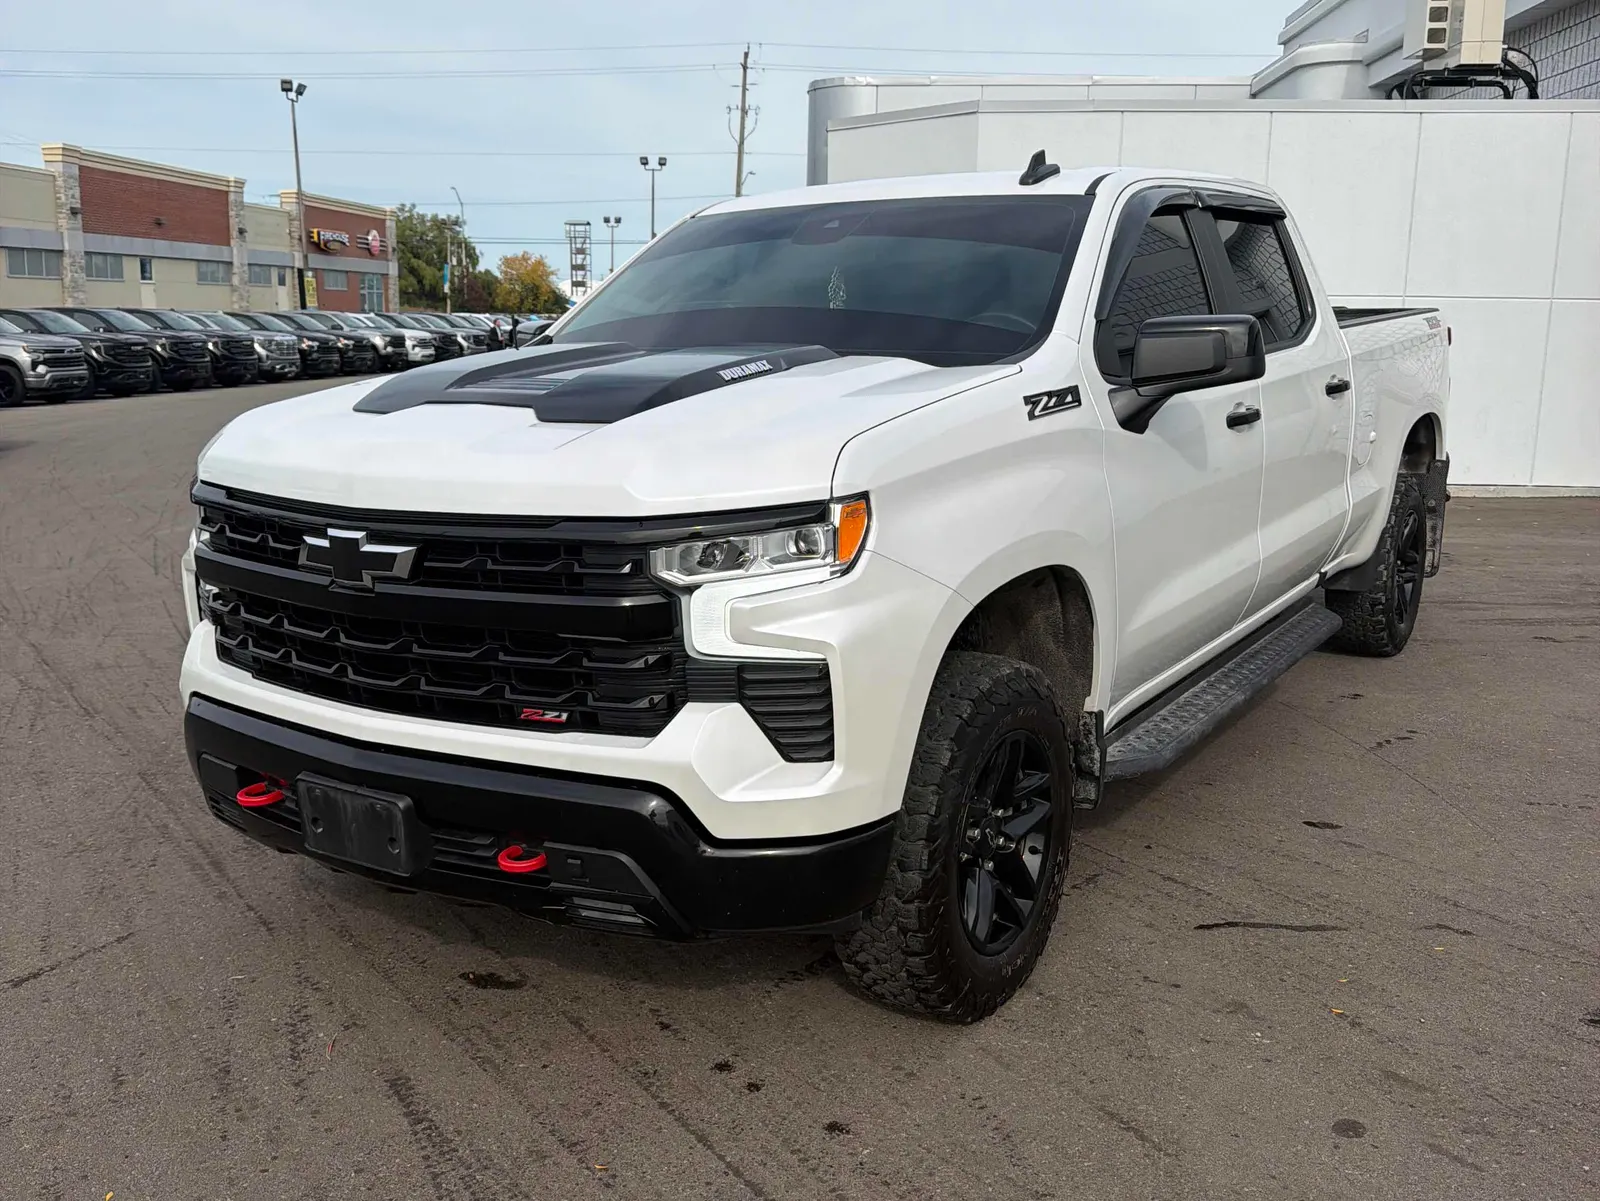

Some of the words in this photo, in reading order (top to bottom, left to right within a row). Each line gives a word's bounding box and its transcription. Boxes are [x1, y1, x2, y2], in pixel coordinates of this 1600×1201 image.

[716, 360, 773, 381] DURAMAX
[1023, 384, 1082, 421] Z71
[520, 708, 569, 723] Z71
